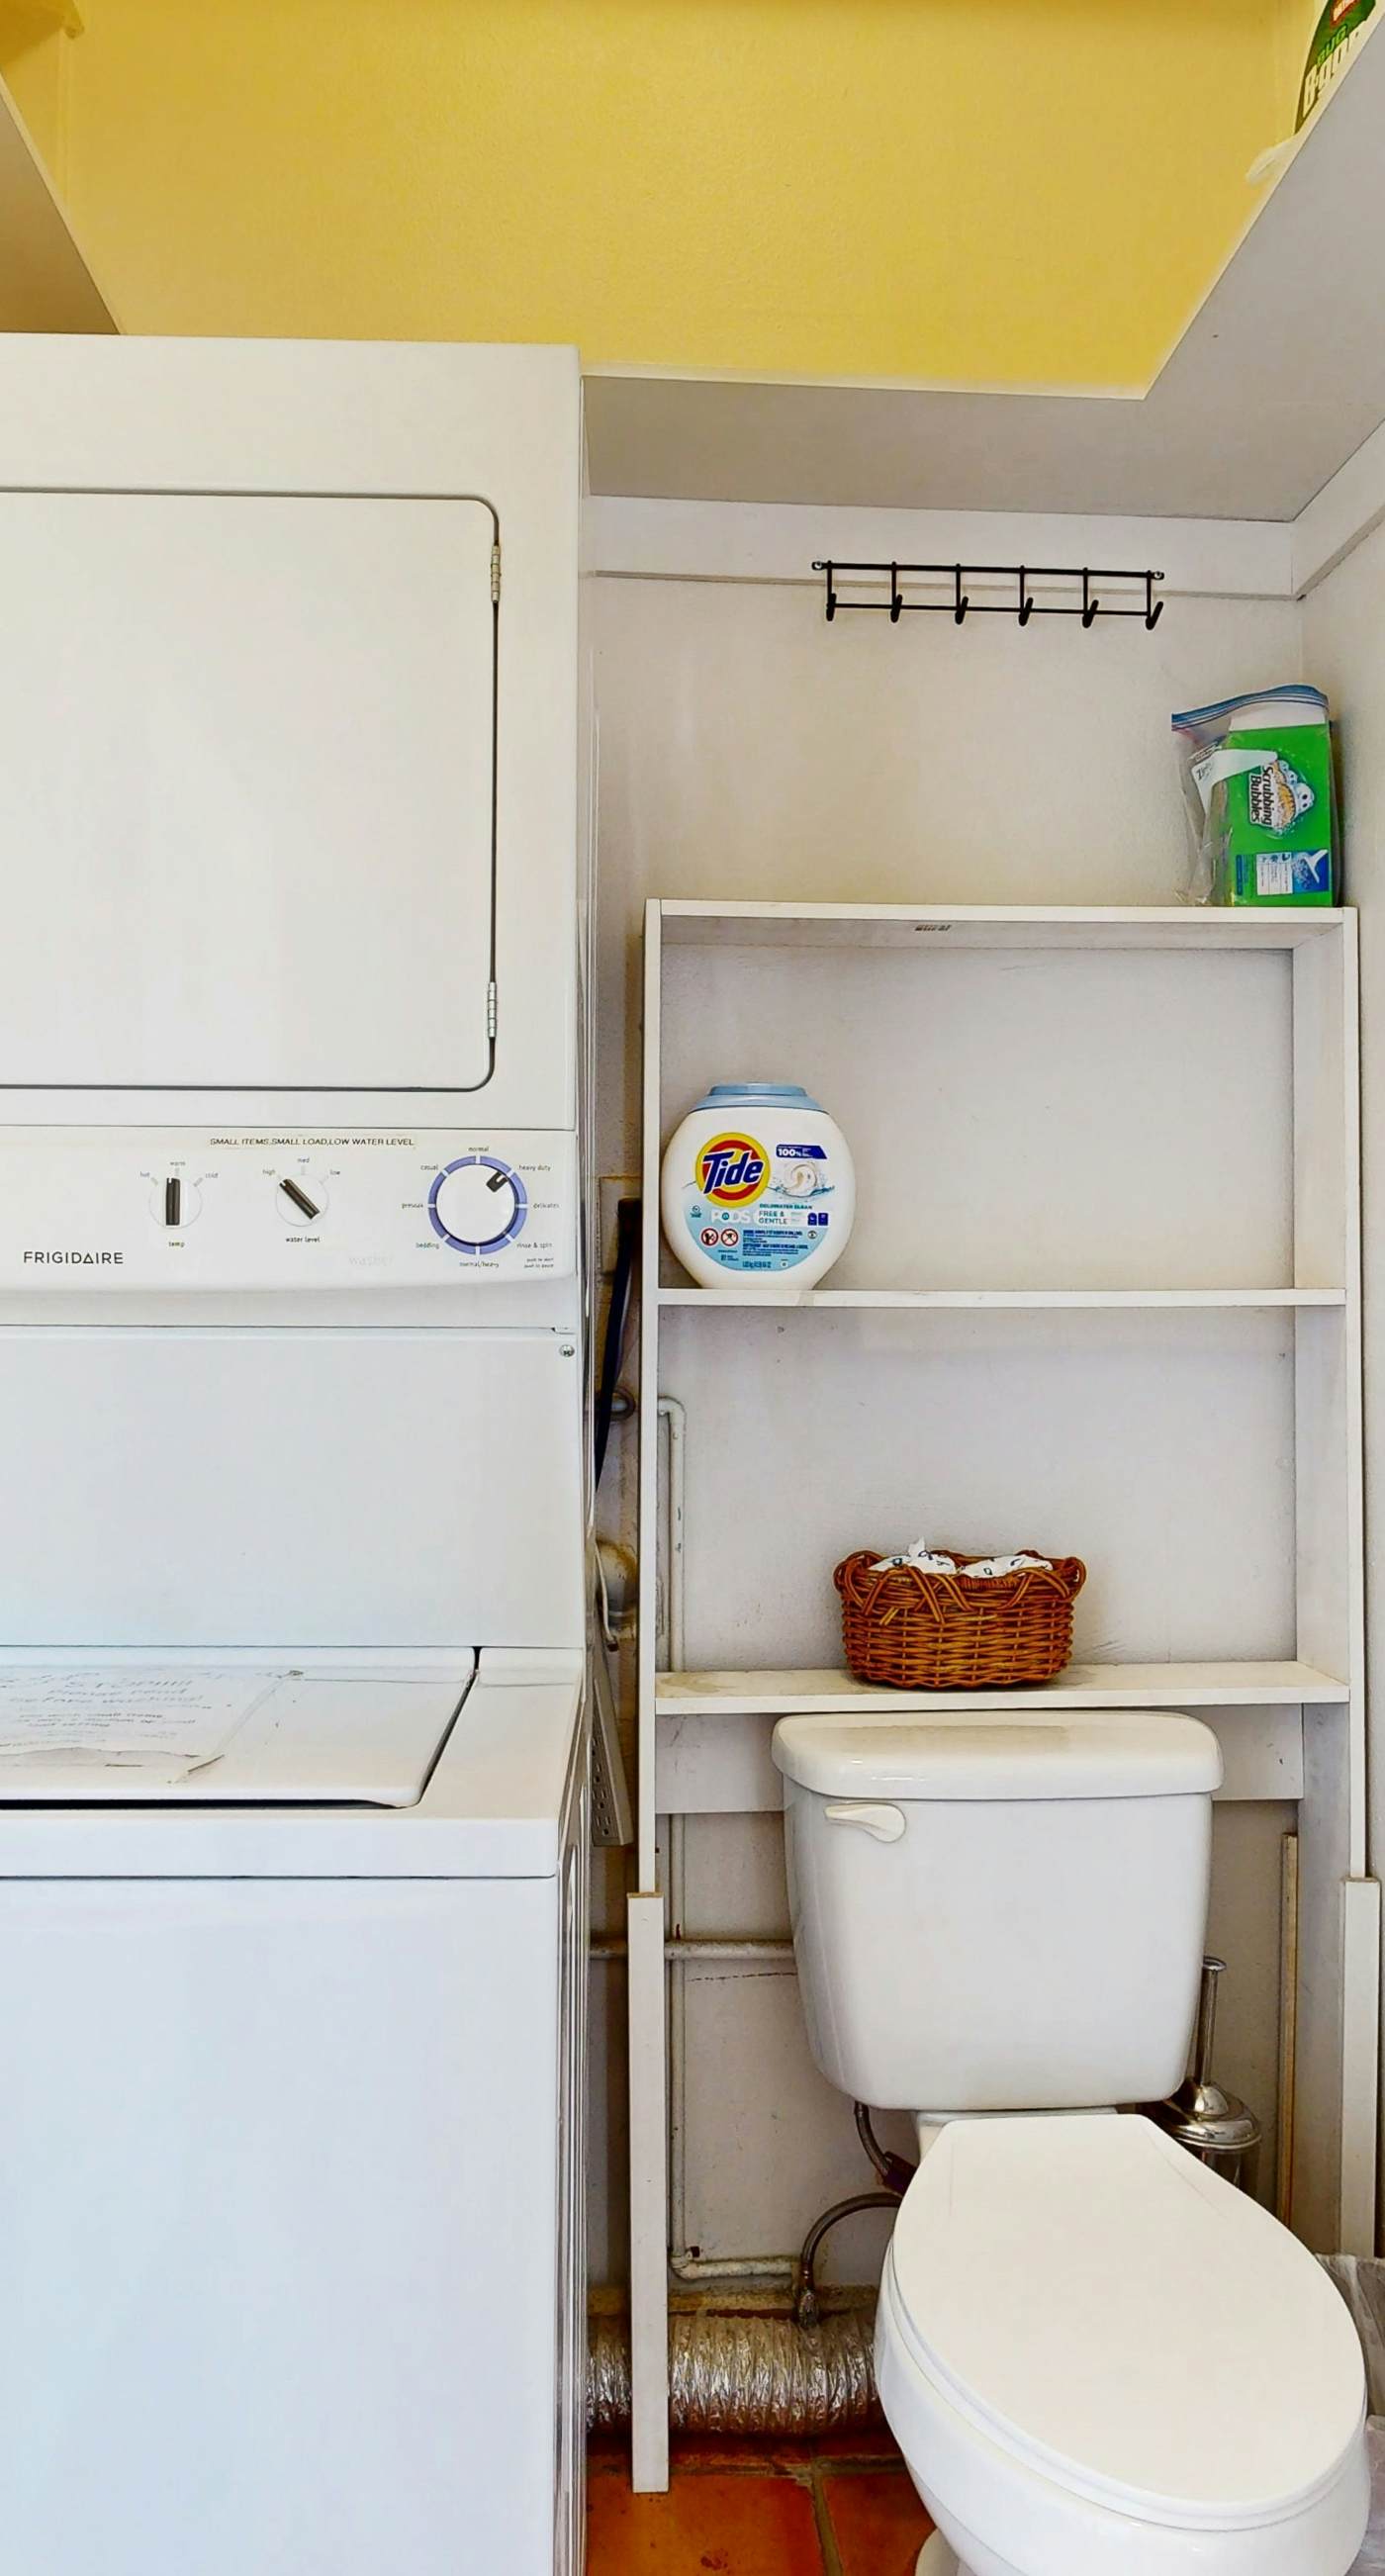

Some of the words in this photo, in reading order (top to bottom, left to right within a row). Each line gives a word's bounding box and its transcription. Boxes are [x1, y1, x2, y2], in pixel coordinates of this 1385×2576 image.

[1250, 775, 1261, 822] Bubbles
[1261, 766, 1274, 826] Scrubbing
[702, 1150, 765, 1195] Tide
[24, 1251, 124, 1264] FRIGIDAIRE
